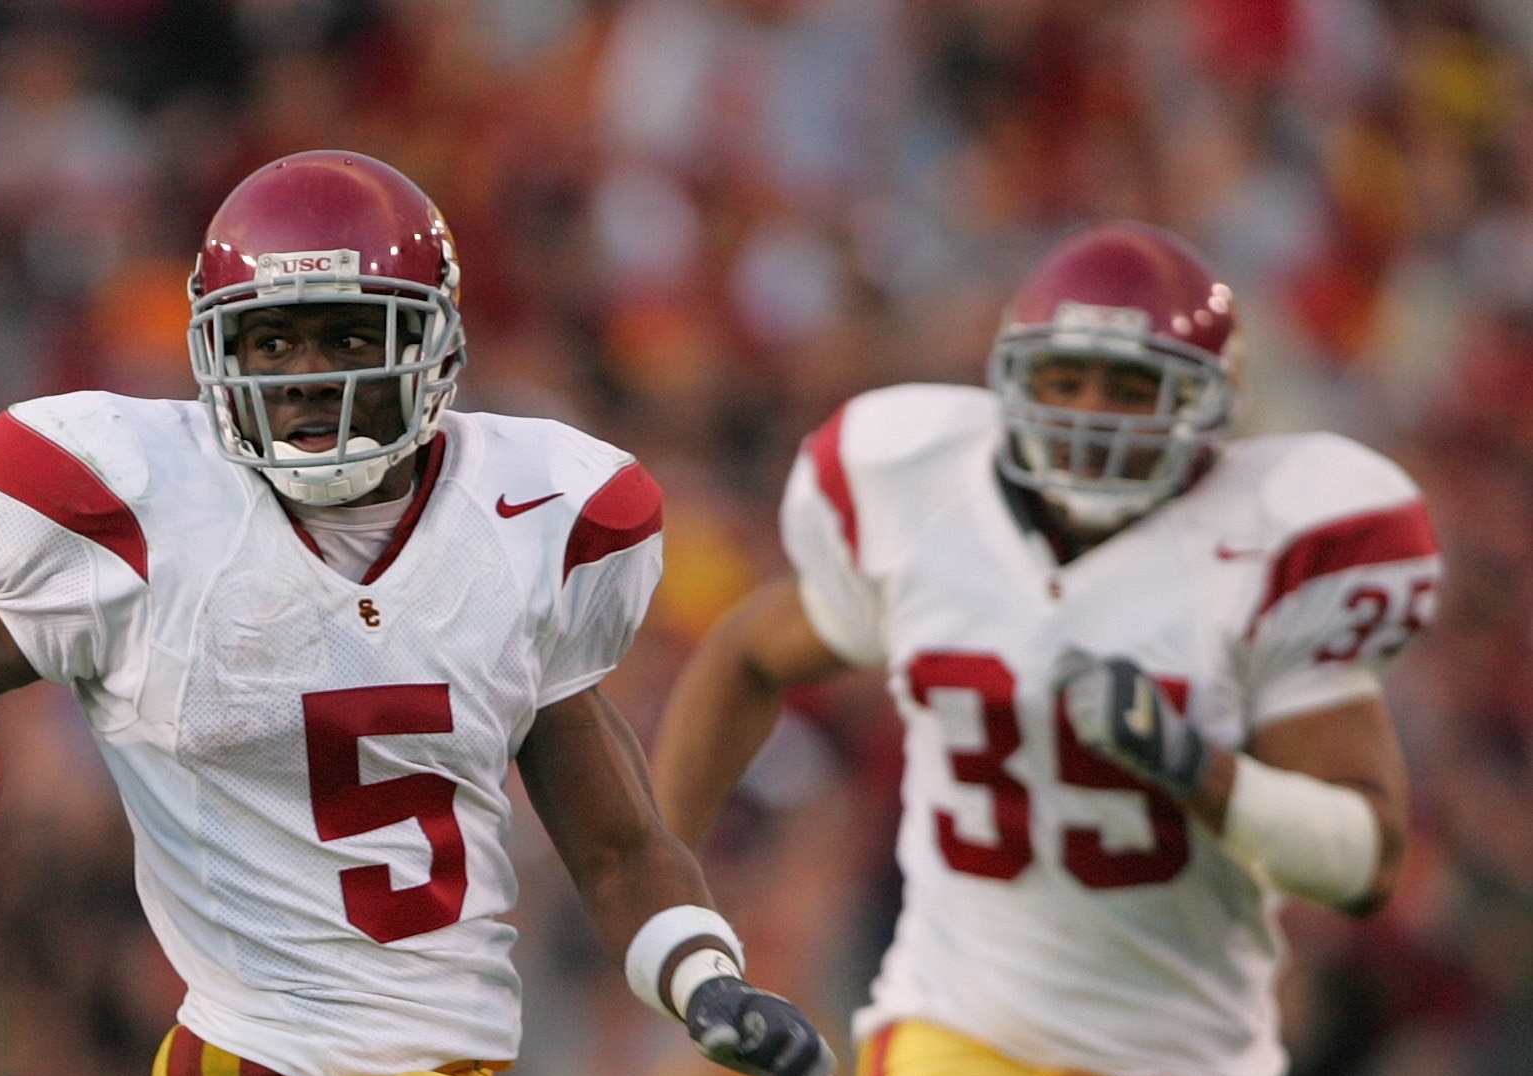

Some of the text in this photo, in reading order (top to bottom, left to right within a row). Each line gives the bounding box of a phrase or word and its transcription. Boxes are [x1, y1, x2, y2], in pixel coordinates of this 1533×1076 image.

[281, 257, 332, 274] USC
[1313, 578, 1433, 664] 35
[302, 683, 468, 944] 5
[907, 652, 1191, 892] 35
